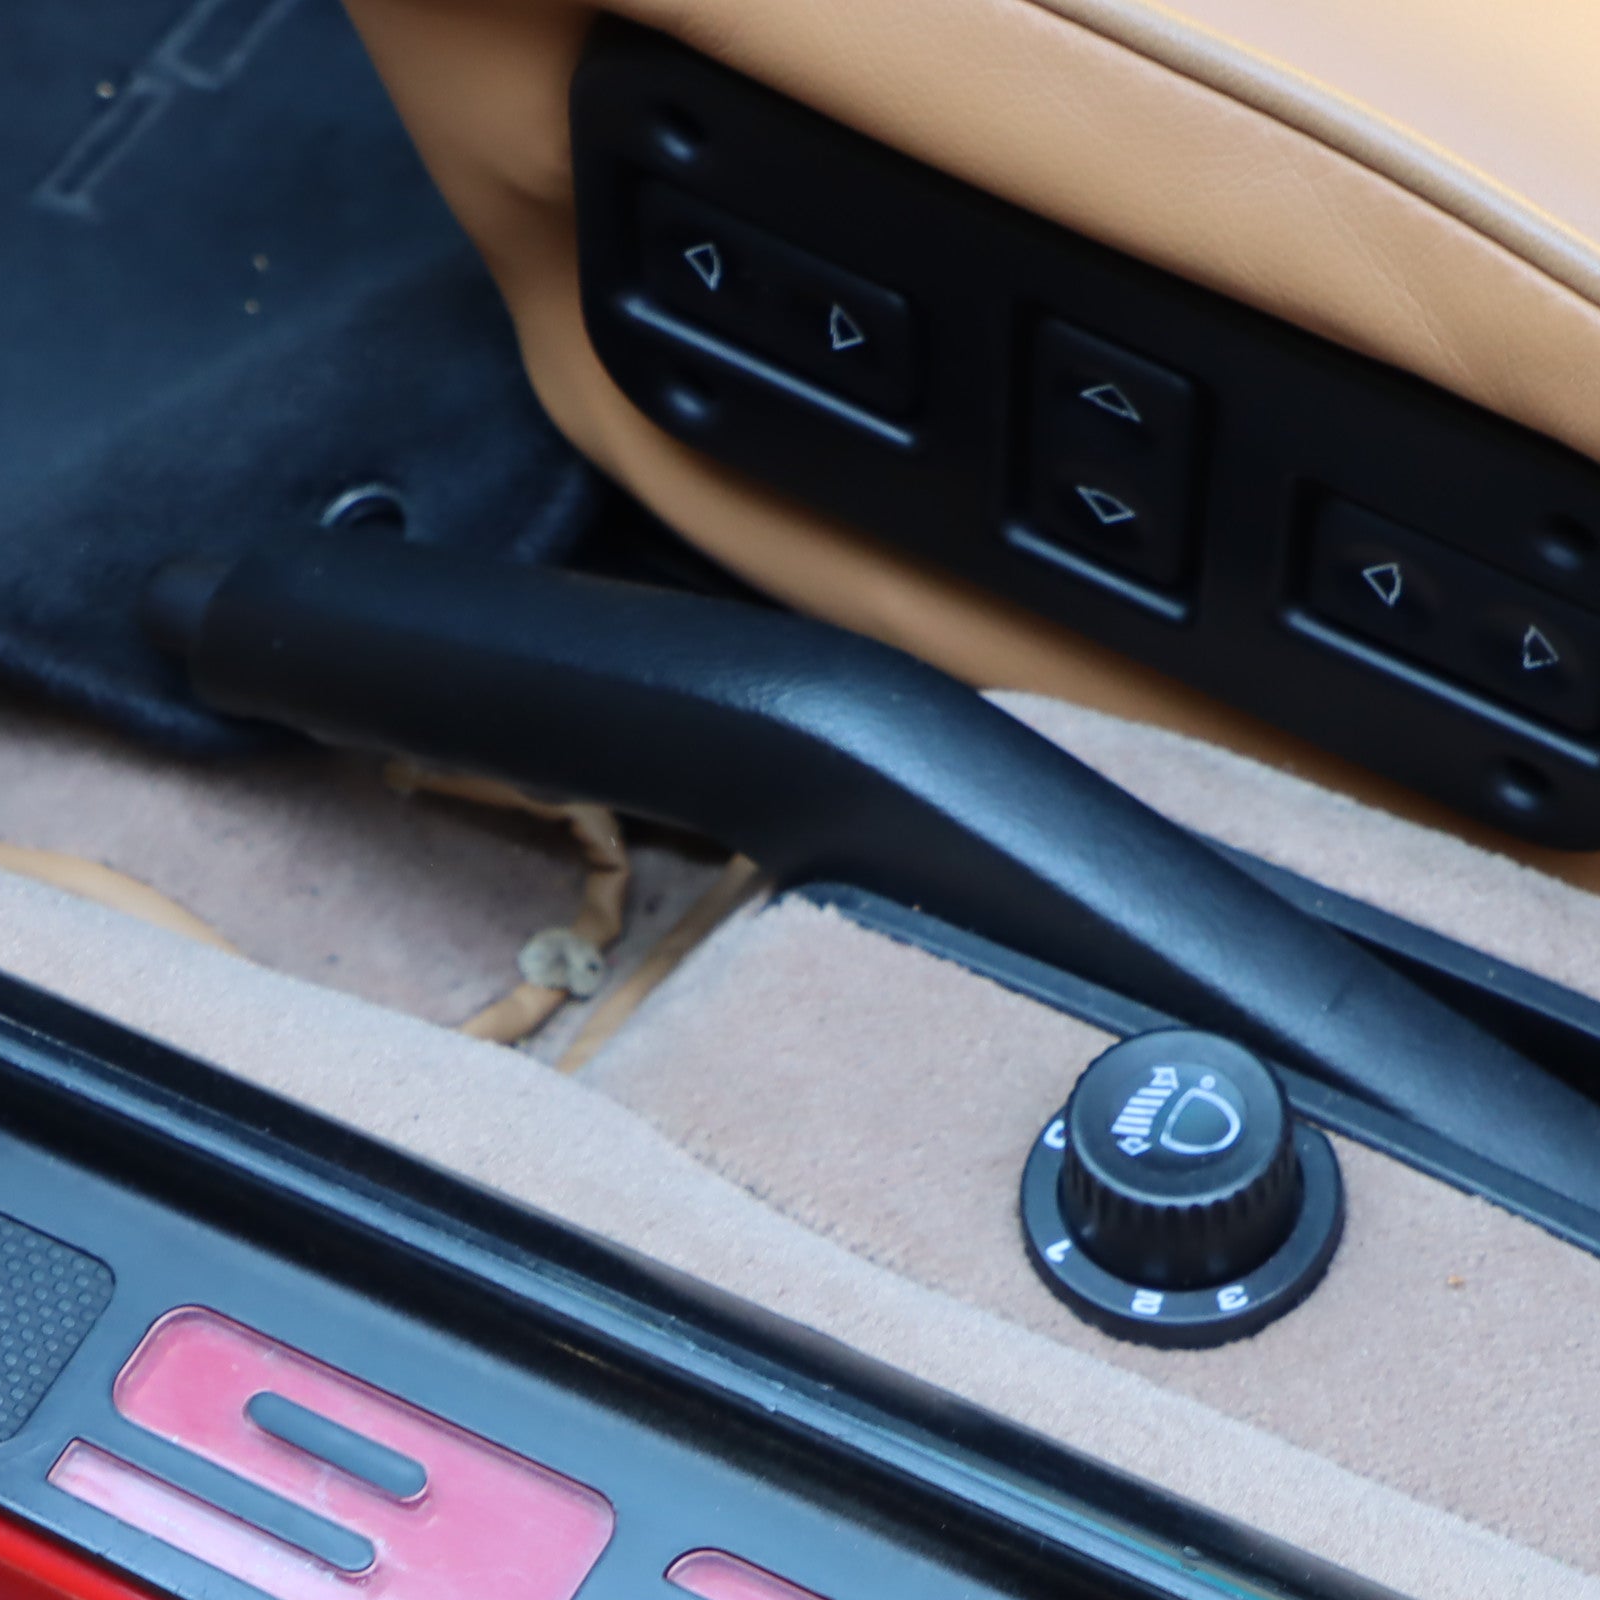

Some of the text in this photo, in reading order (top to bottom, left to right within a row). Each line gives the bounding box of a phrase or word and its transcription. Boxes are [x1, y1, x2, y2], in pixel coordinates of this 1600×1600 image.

[1045, 1238, 1072, 1264] 1
[1131, 1288, 1165, 1316] 2
[1216, 1284, 1250, 1313] 3
